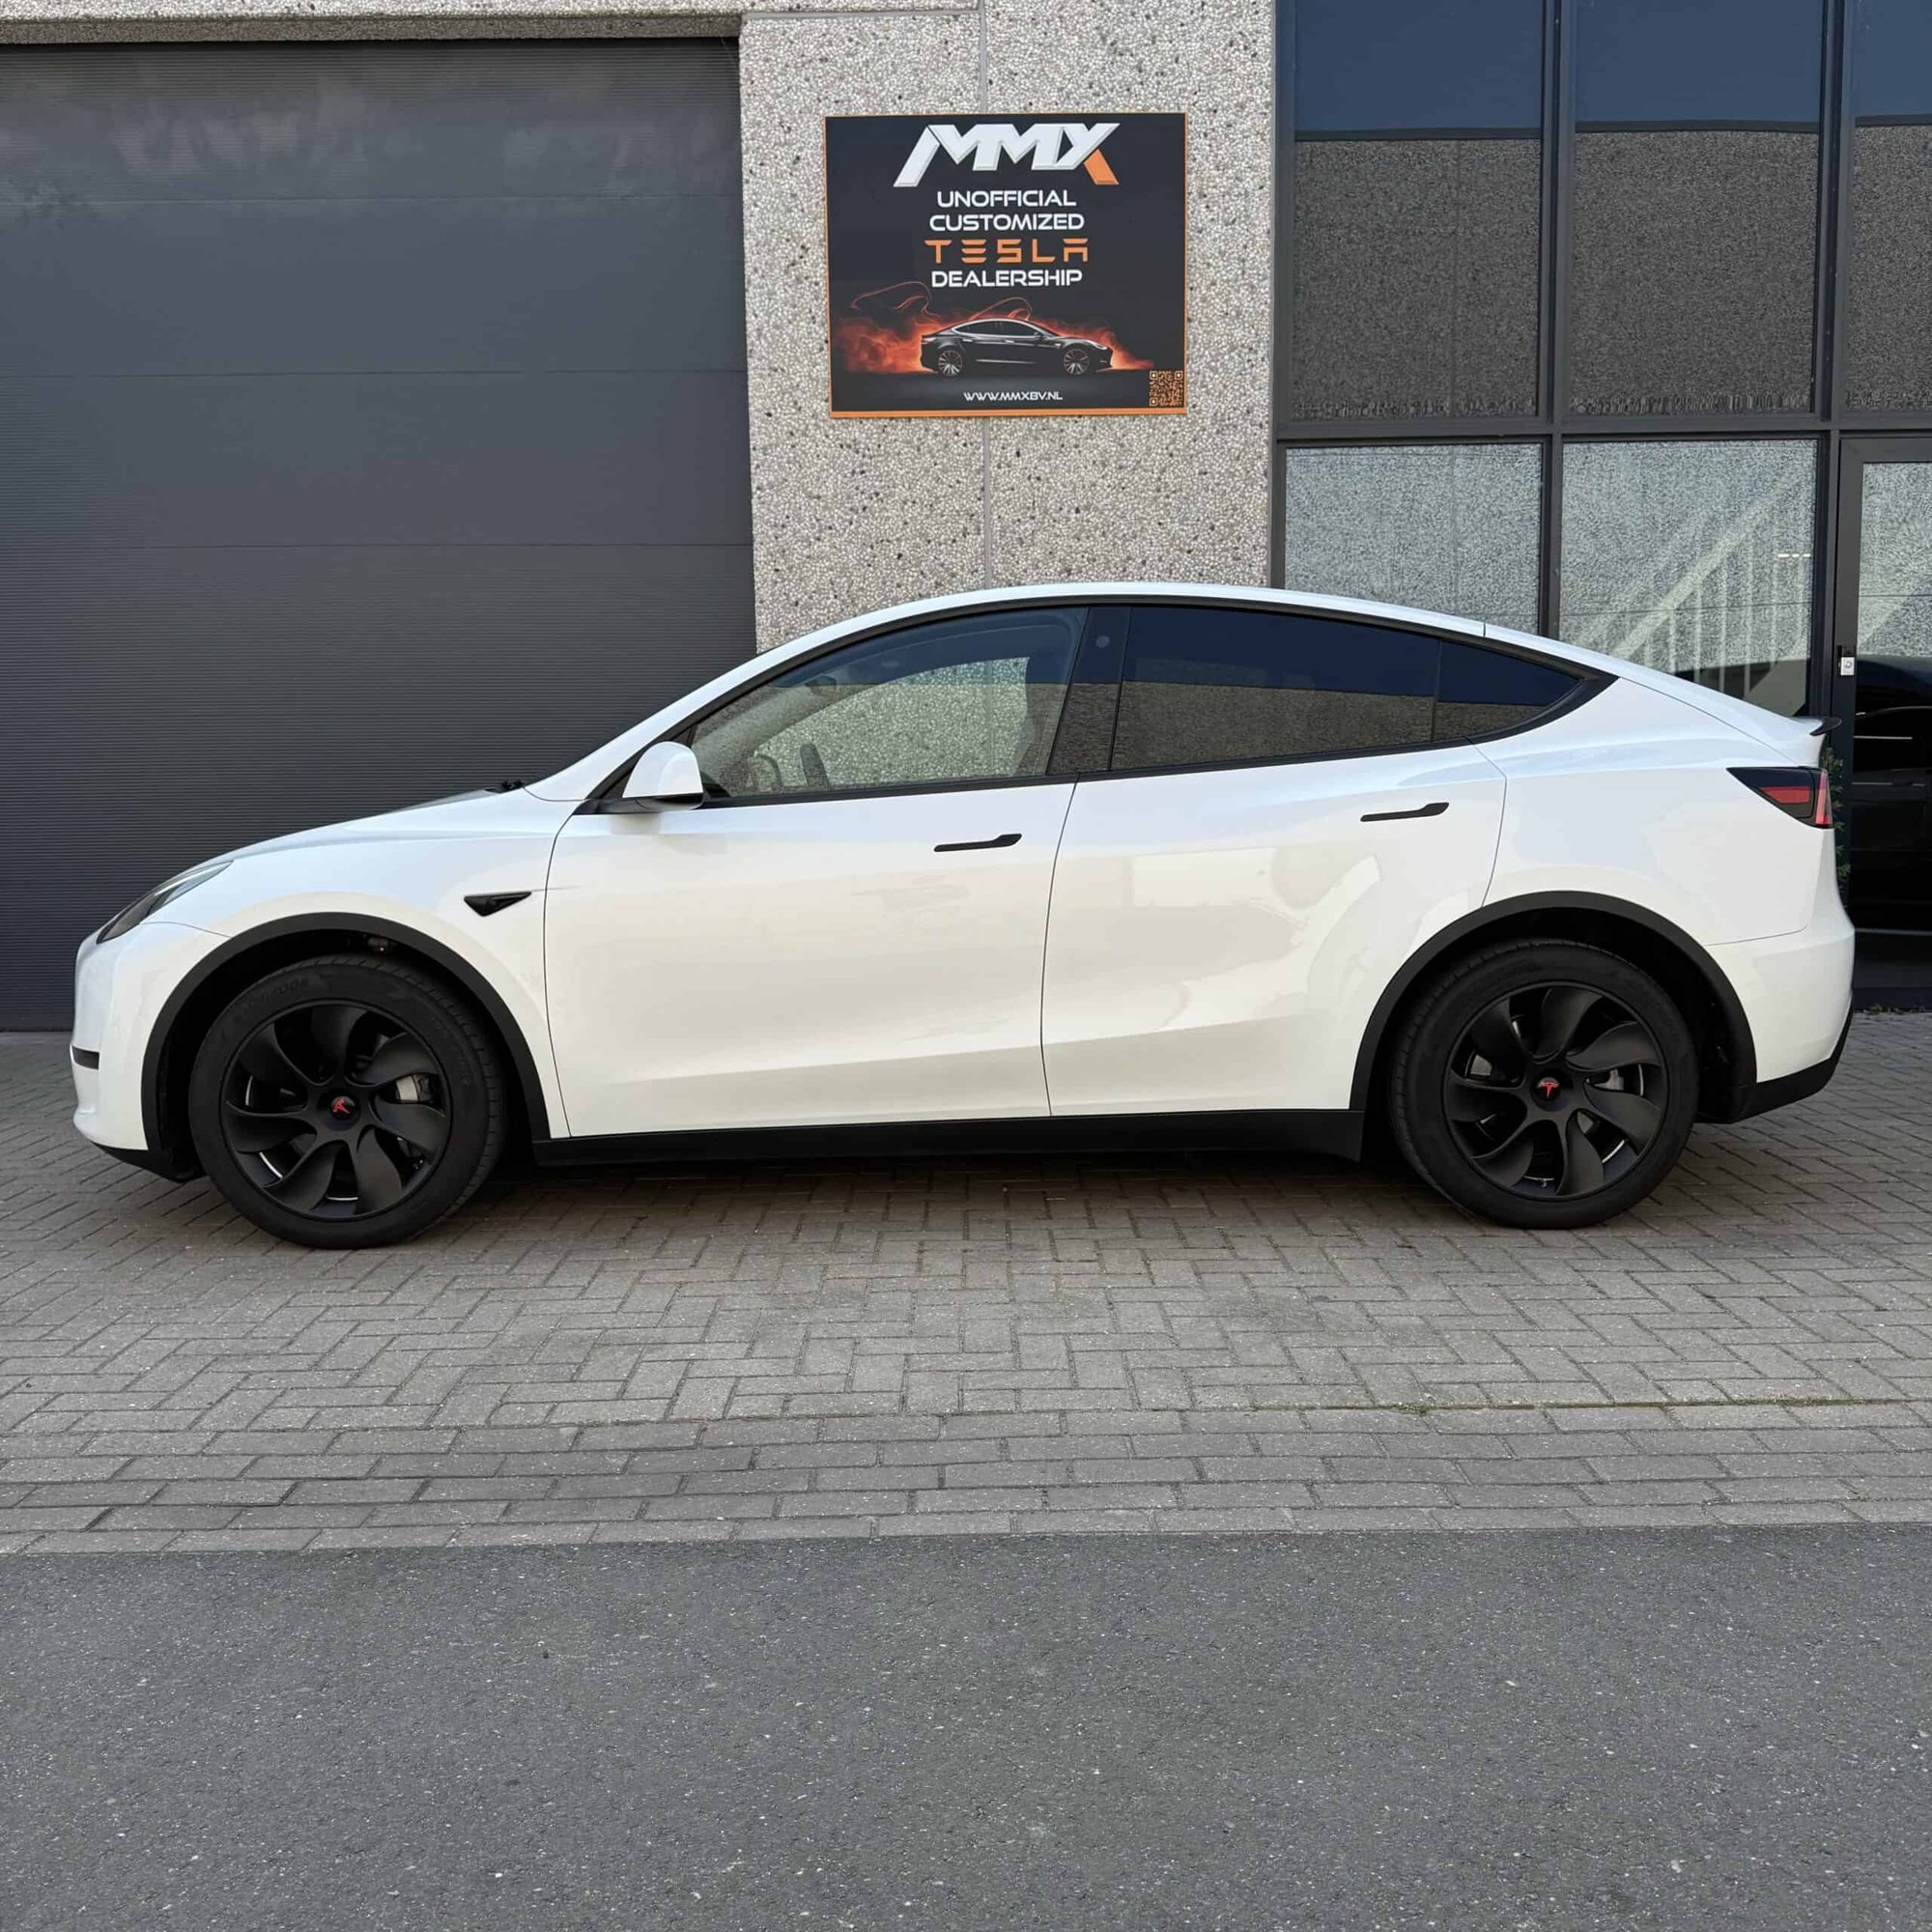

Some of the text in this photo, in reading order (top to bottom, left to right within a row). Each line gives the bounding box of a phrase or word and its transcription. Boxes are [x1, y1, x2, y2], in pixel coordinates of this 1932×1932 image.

[893, 123, 1121, 187] MMX
[937, 189, 1077, 208] UNOFFICIAL
[929, 213, 1085, 232] CUSTOMIZED
[924, 238, 1089, 264] TESLA
[931, 269, 1083, 288] DEALERSHIP
[963, 391, 1064, 402] WWW.MMXBV.NL
